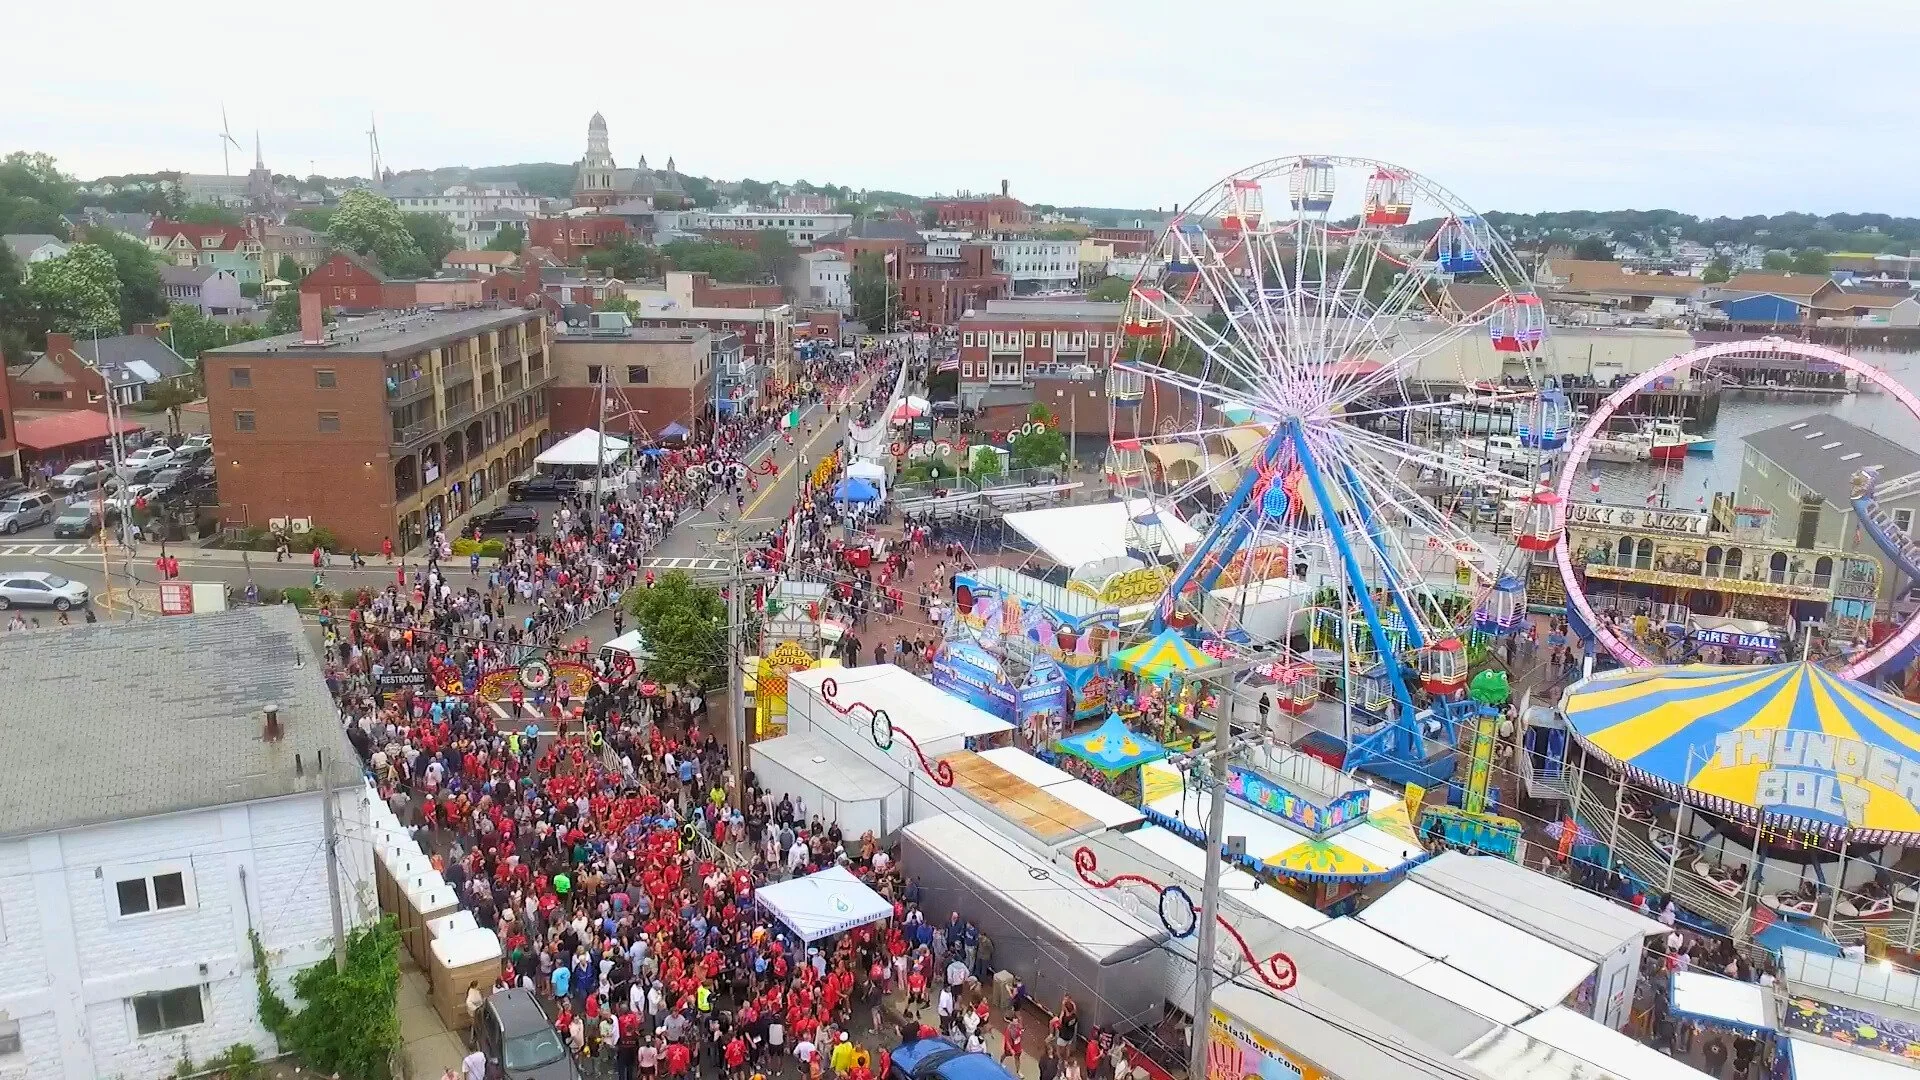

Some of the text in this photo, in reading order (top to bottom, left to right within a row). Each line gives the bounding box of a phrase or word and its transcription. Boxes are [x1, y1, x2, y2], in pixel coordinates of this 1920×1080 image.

[1566, 504, 1701, 533] UCKY LIZZY
[1739, 635, 1777, 648] BALL
[770, 658, 811, 667] DOUGH
[381, 674, 425, 684] RESTROOMS
[1022, 686, 1061, 702] SUNDAES
[1711, 731, 1920, 811] THUNDER
[1754, 770, 1870, 829] BOLT
[1209, 1013, 1301, 1075] iestaShows.com
